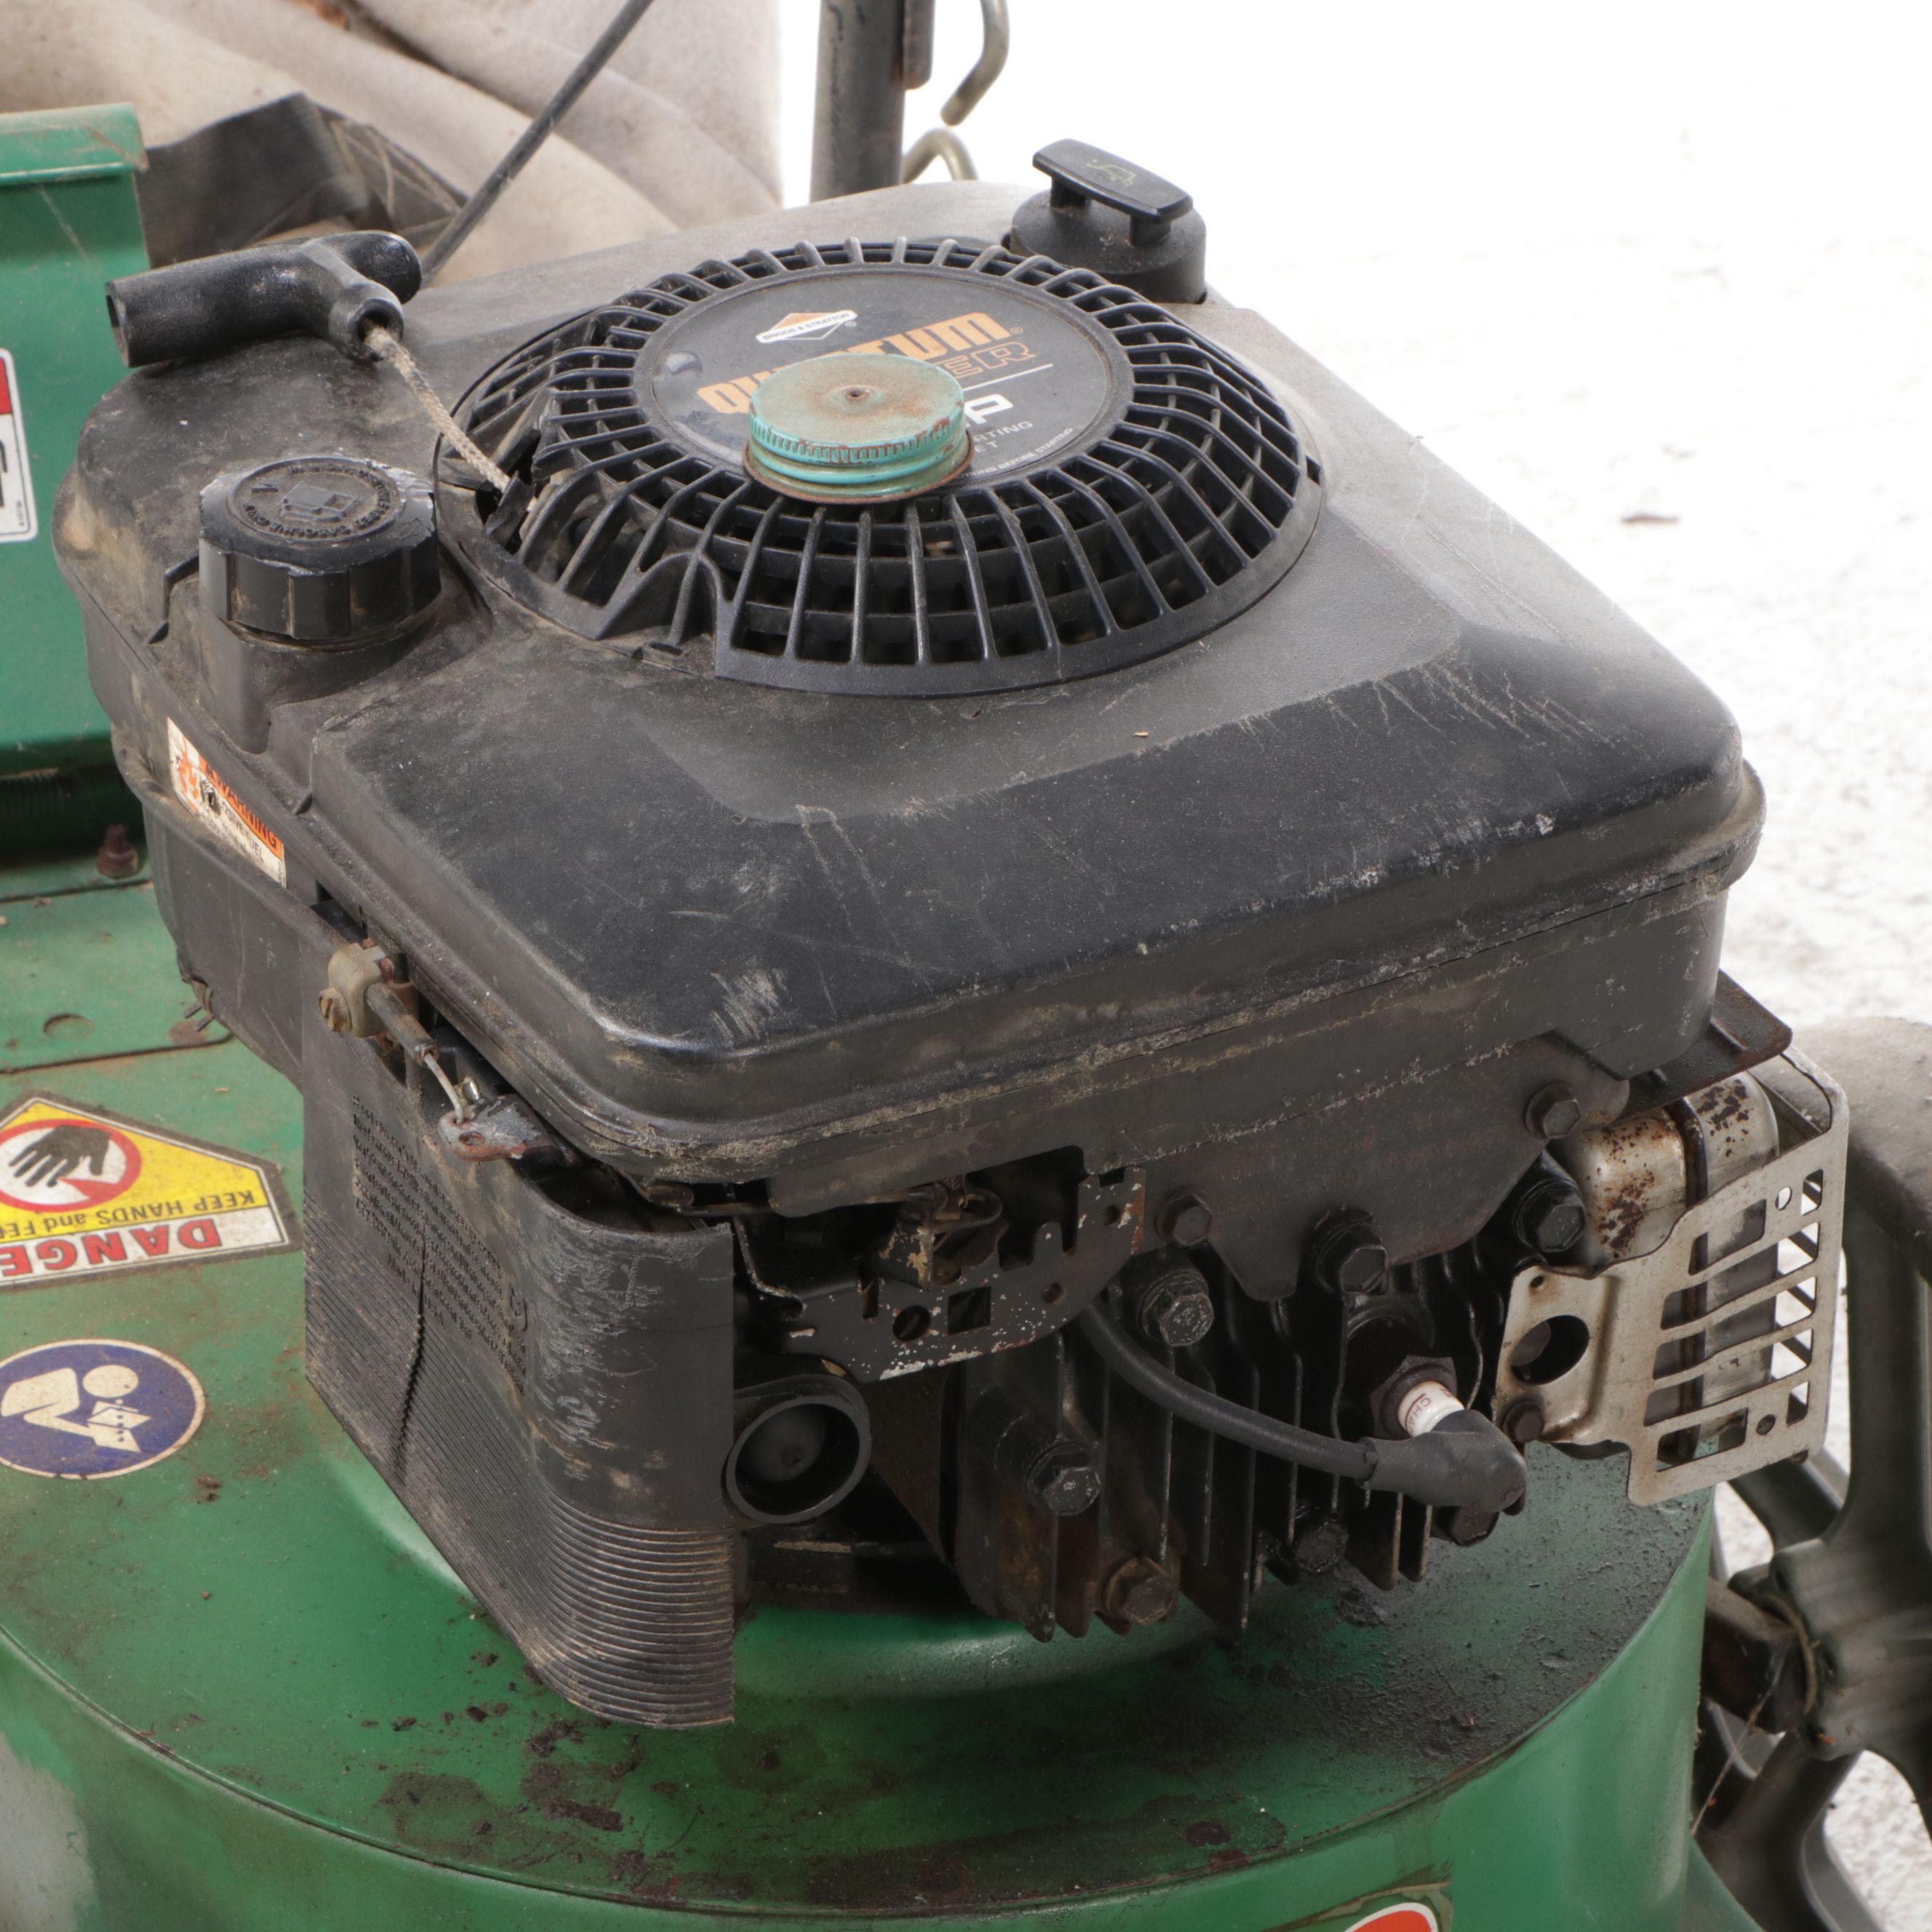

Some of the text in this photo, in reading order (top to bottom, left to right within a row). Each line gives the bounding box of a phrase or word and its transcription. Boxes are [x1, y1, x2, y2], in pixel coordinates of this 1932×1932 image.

[805, 311, 850, 327] STRATTON
[1034, 427, 1074, 453] STARTING
[219, 775, 277, 850] WARNING
[95, 1200, 183, 1225] HANDS
[193, 1190, 256, 1211] KEEP
[44, 1213, 87, 1232] and
[0, 1218, 222, 1277] DANGE
[1408, 1397, 1432, 1426] CHA
